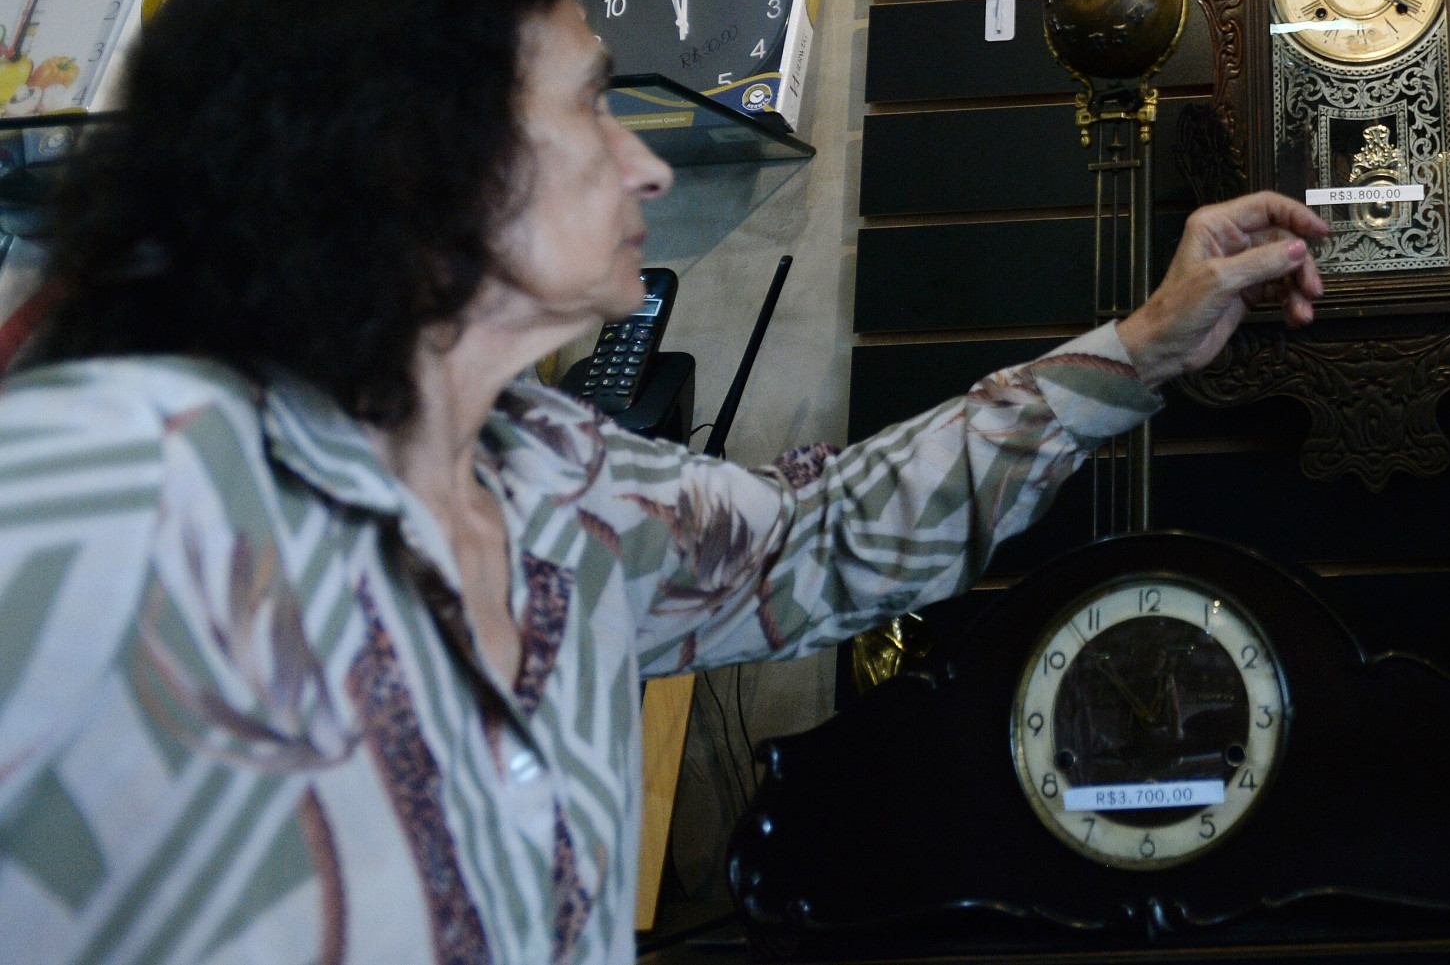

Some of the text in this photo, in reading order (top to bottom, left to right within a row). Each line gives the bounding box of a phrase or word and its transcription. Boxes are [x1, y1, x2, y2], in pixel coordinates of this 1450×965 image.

[750, 39, 767, 60] 4
[1139, 590, 1161, 612] 12
[1088, 608, 1099, 630] 11
[1204, 604, 1209, 625] 1
[1044, 651, 1066, 674] 10
[1240, 646, 1259, 668] 2
[1028, 713, 1044, 736] 9
[1256, 705, 1272, 729] 3
[1041, 773, 1058, 799] 8
[1239, 769, 1256, 791] 4
[1081, 818, 1096, 843] 7
[1199, 814, 1215, 837] 5
[1139, 834, 1155, 858] 6
